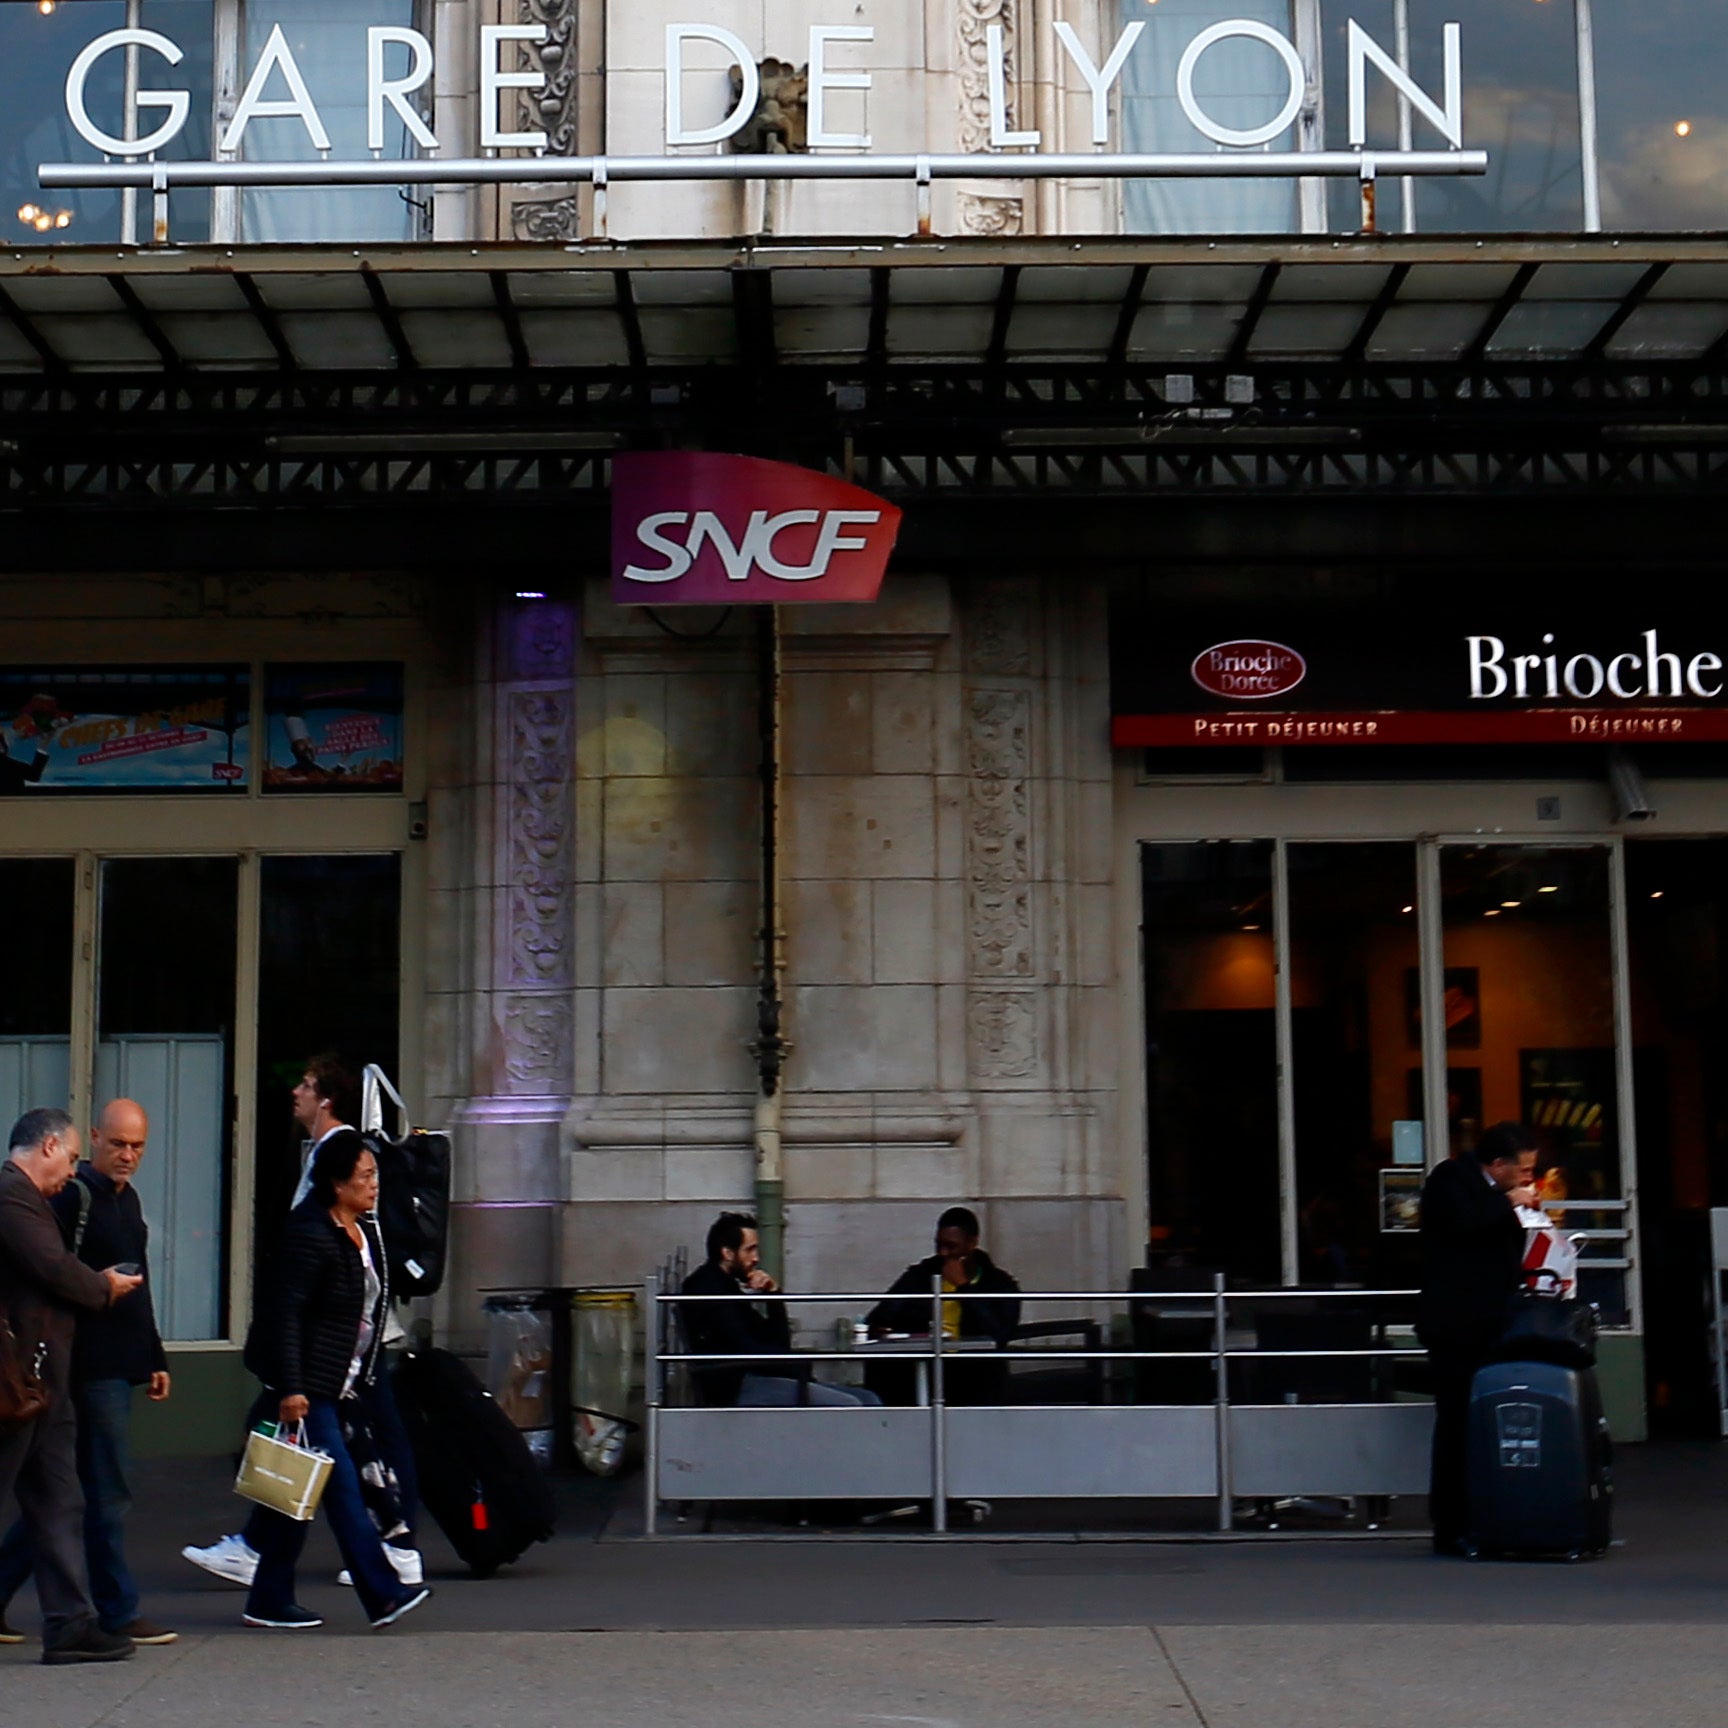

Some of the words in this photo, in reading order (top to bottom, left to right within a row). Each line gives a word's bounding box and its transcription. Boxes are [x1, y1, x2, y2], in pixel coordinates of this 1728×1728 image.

[65, 22, 548, 156] GARE
[665, 22, 874, 148] DE
[985, 18, 1462, 150] LYON
[623, 509, 881, 582] SNCF
[1209, 648, 1292, 674] Brioche
[1464, 628, 1724, 699] Brioche
[1193, 718, 1259, 737] PETIT
